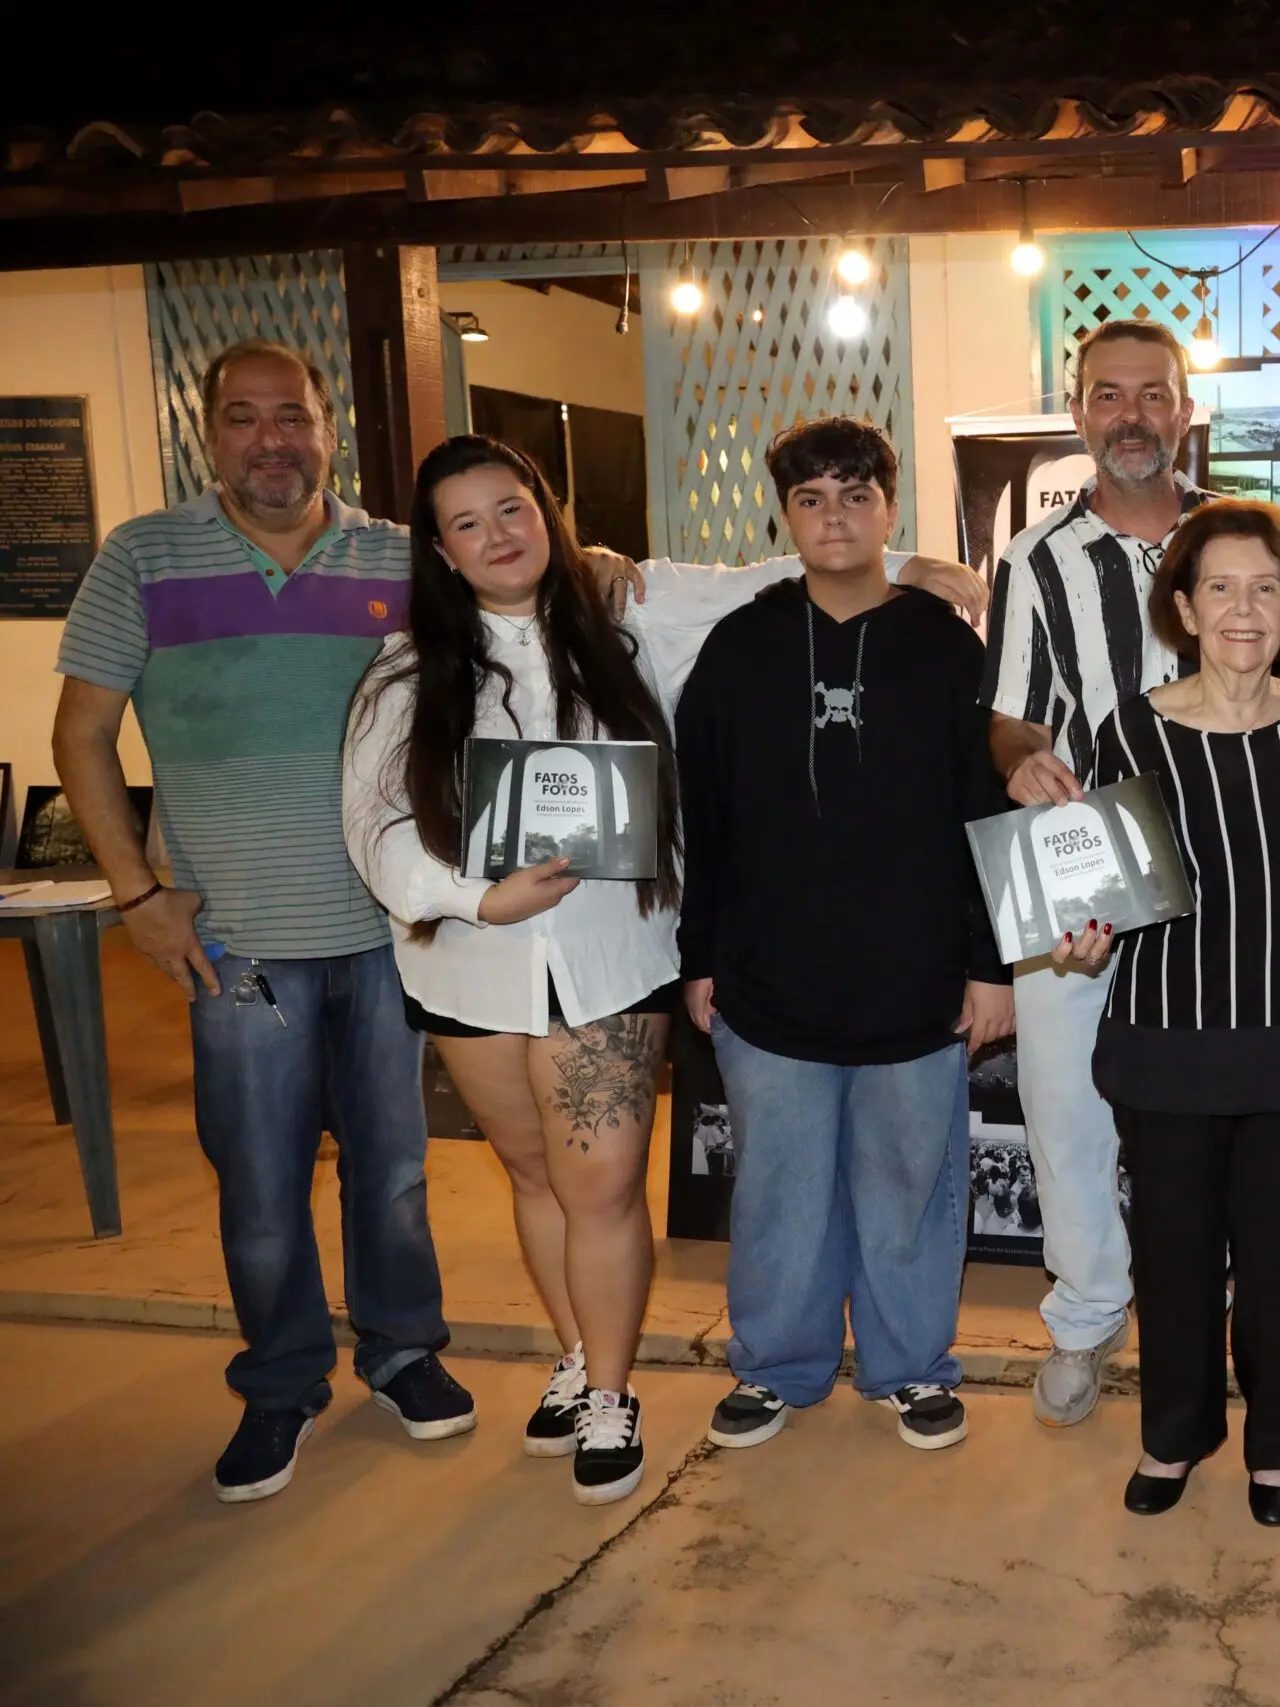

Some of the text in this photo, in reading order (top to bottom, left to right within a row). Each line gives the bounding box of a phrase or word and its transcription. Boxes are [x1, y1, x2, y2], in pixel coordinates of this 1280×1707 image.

[535, 772, 578, 784] FATOS
[542, 784, 588, 796] FOTOS
[536, 804, 585, 813] Edson Lopes
[1043, 826, 1088, 848] FATOS
[1054, 835, 1102, 858] FOTOS
[1055, 865, 1080, 877] Edson
[1081, 858, 1105, 870] Lopes
